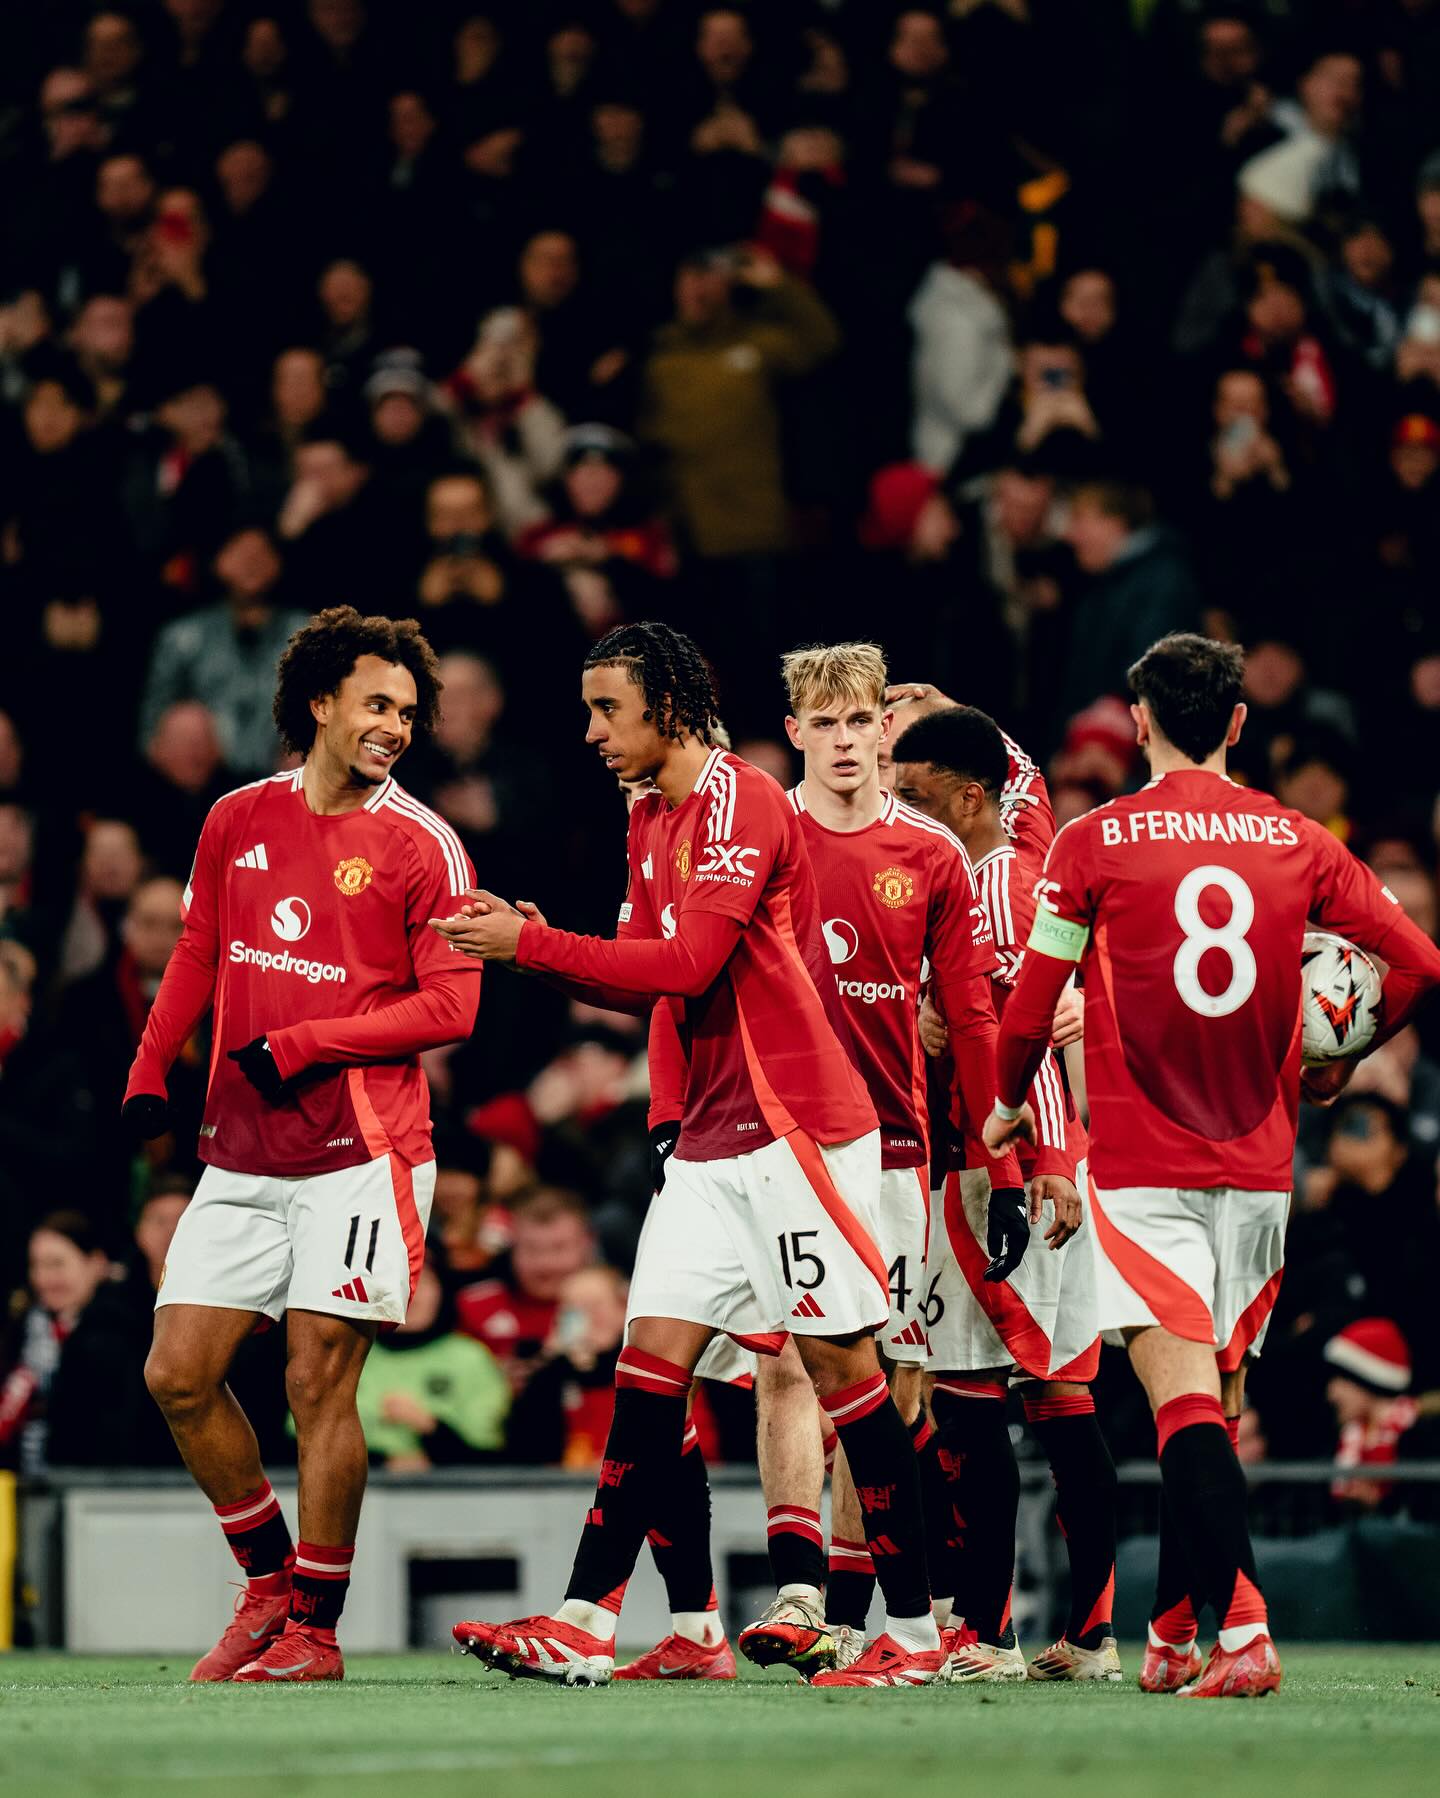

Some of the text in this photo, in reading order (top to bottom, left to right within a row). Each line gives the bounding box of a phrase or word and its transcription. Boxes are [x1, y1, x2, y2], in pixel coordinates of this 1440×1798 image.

[1101, 811, 1298, 846] B.FERNANDES
[695, 873, 753, 888] TECHNOLOGY
[697, 845, 760, 878] DXC
[1173, 864, 1257, 1018] 8
[229, 940, 347, 984] Snapdragon
[834, 974, 905, 1004] ragon
[344, 1214, 381, 1275] 11
[777, 1230, 825, 1291] 15
